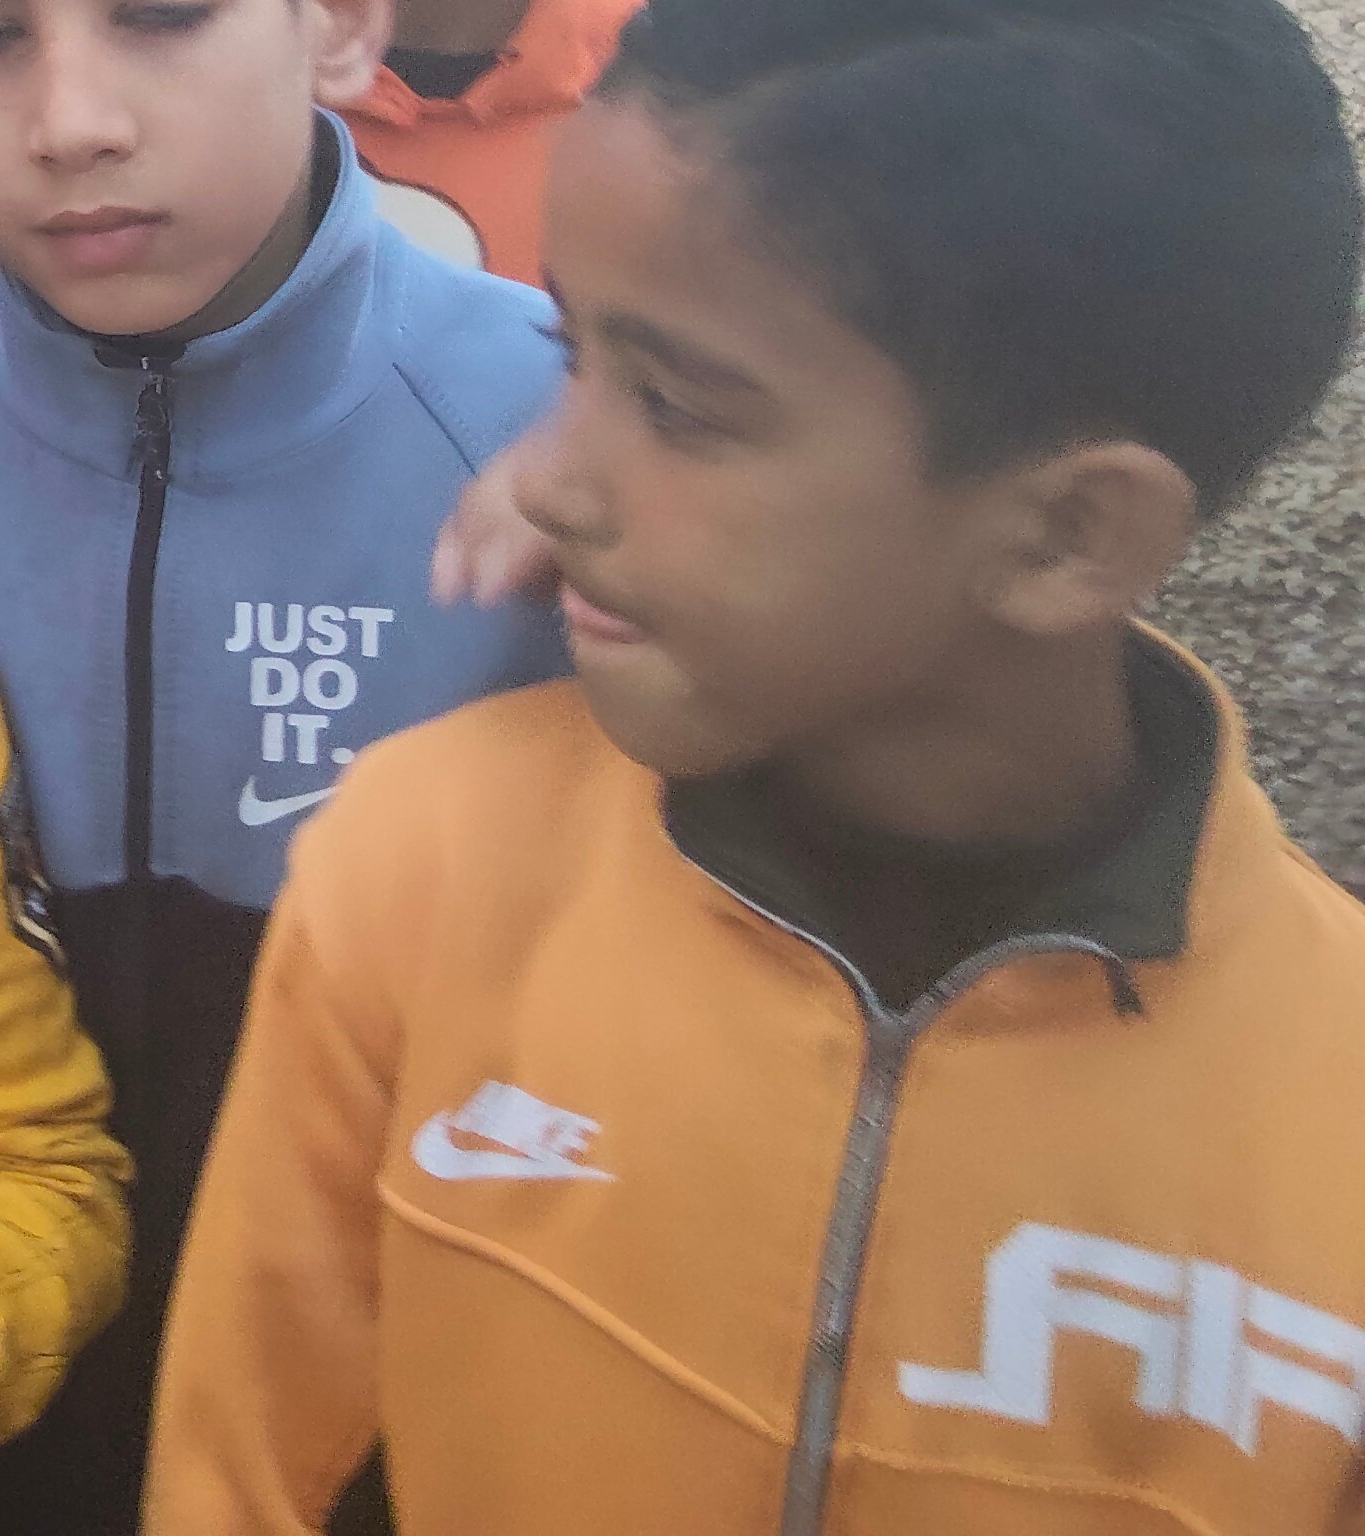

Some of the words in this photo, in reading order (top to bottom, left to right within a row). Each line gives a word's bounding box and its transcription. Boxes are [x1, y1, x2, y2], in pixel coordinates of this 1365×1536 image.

[224, 601, 395, 658] JUST
[249, 656, 359, 710] DO
[261, 712, 356, 765] IT.
